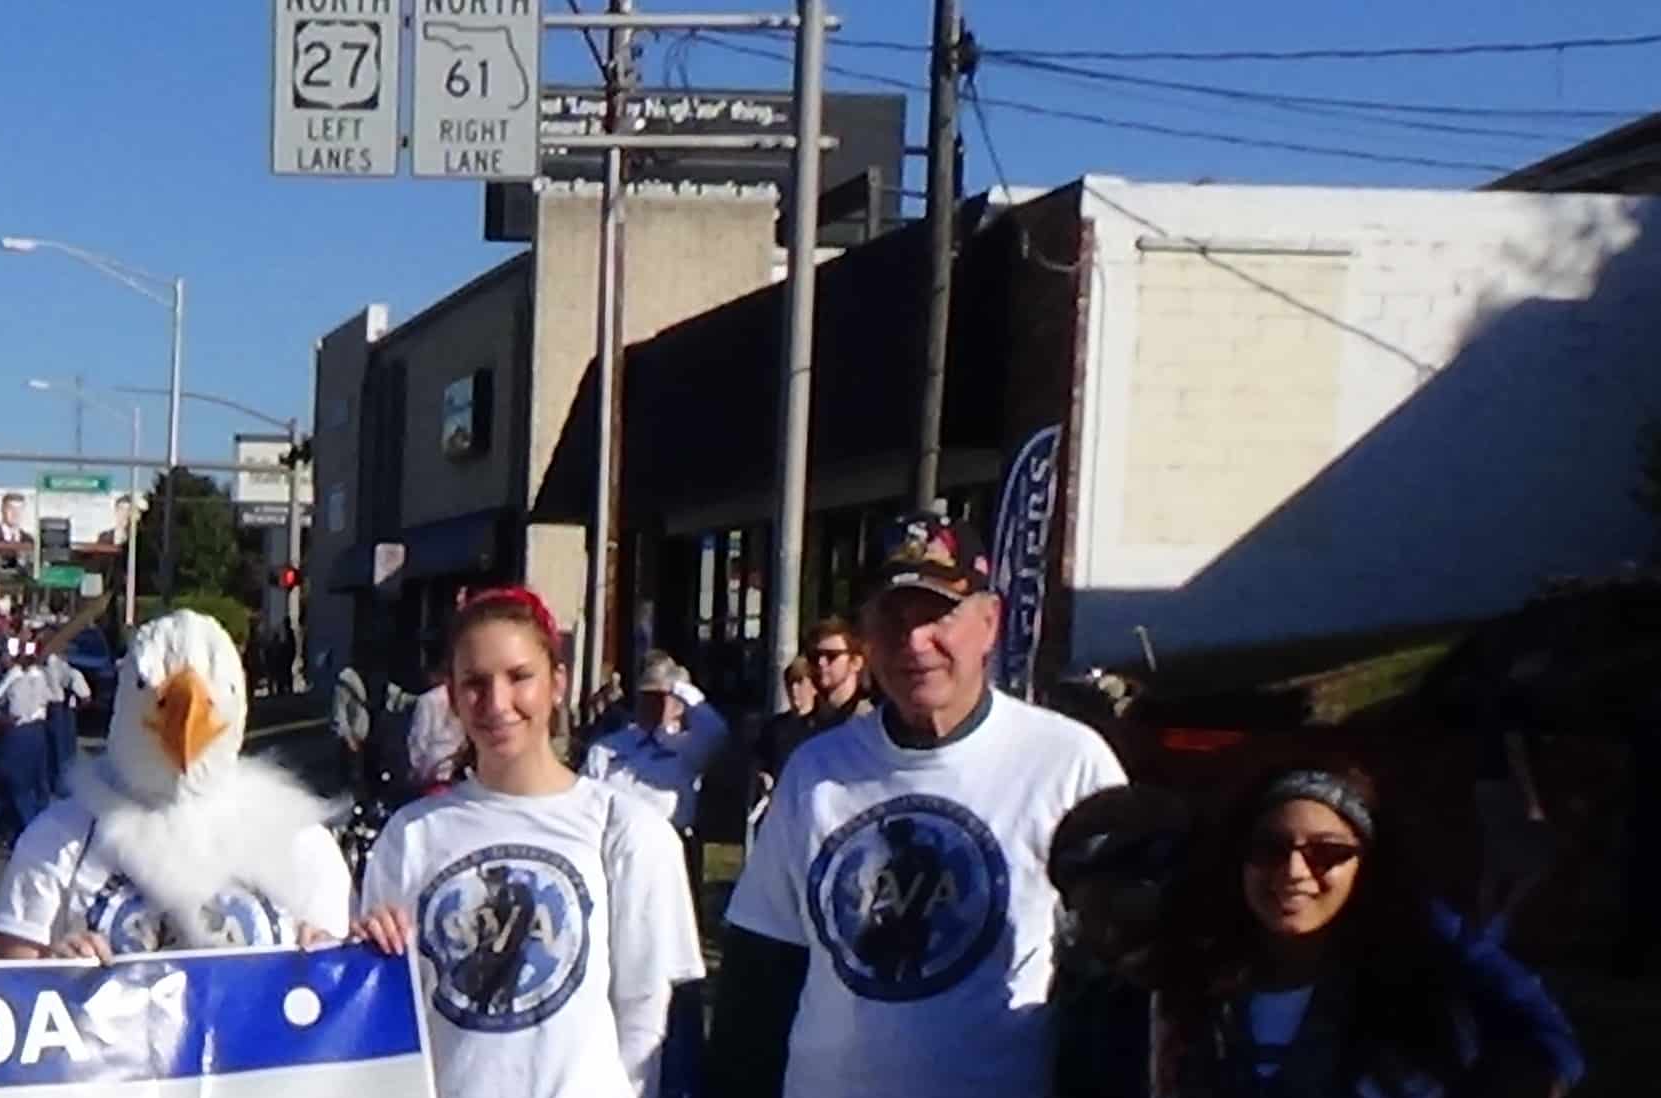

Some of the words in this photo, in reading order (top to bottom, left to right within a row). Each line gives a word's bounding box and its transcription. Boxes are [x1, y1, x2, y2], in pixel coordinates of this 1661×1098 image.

[303, 41, 369, 88] 27
[445, 59, 488, 97] 61
[307, 118, 364, 141] LEFT
[440, 119, 508, 143] RIGHT
[297, 148, 371, 171] LANES
[444, 150, 502, 174] LANE
